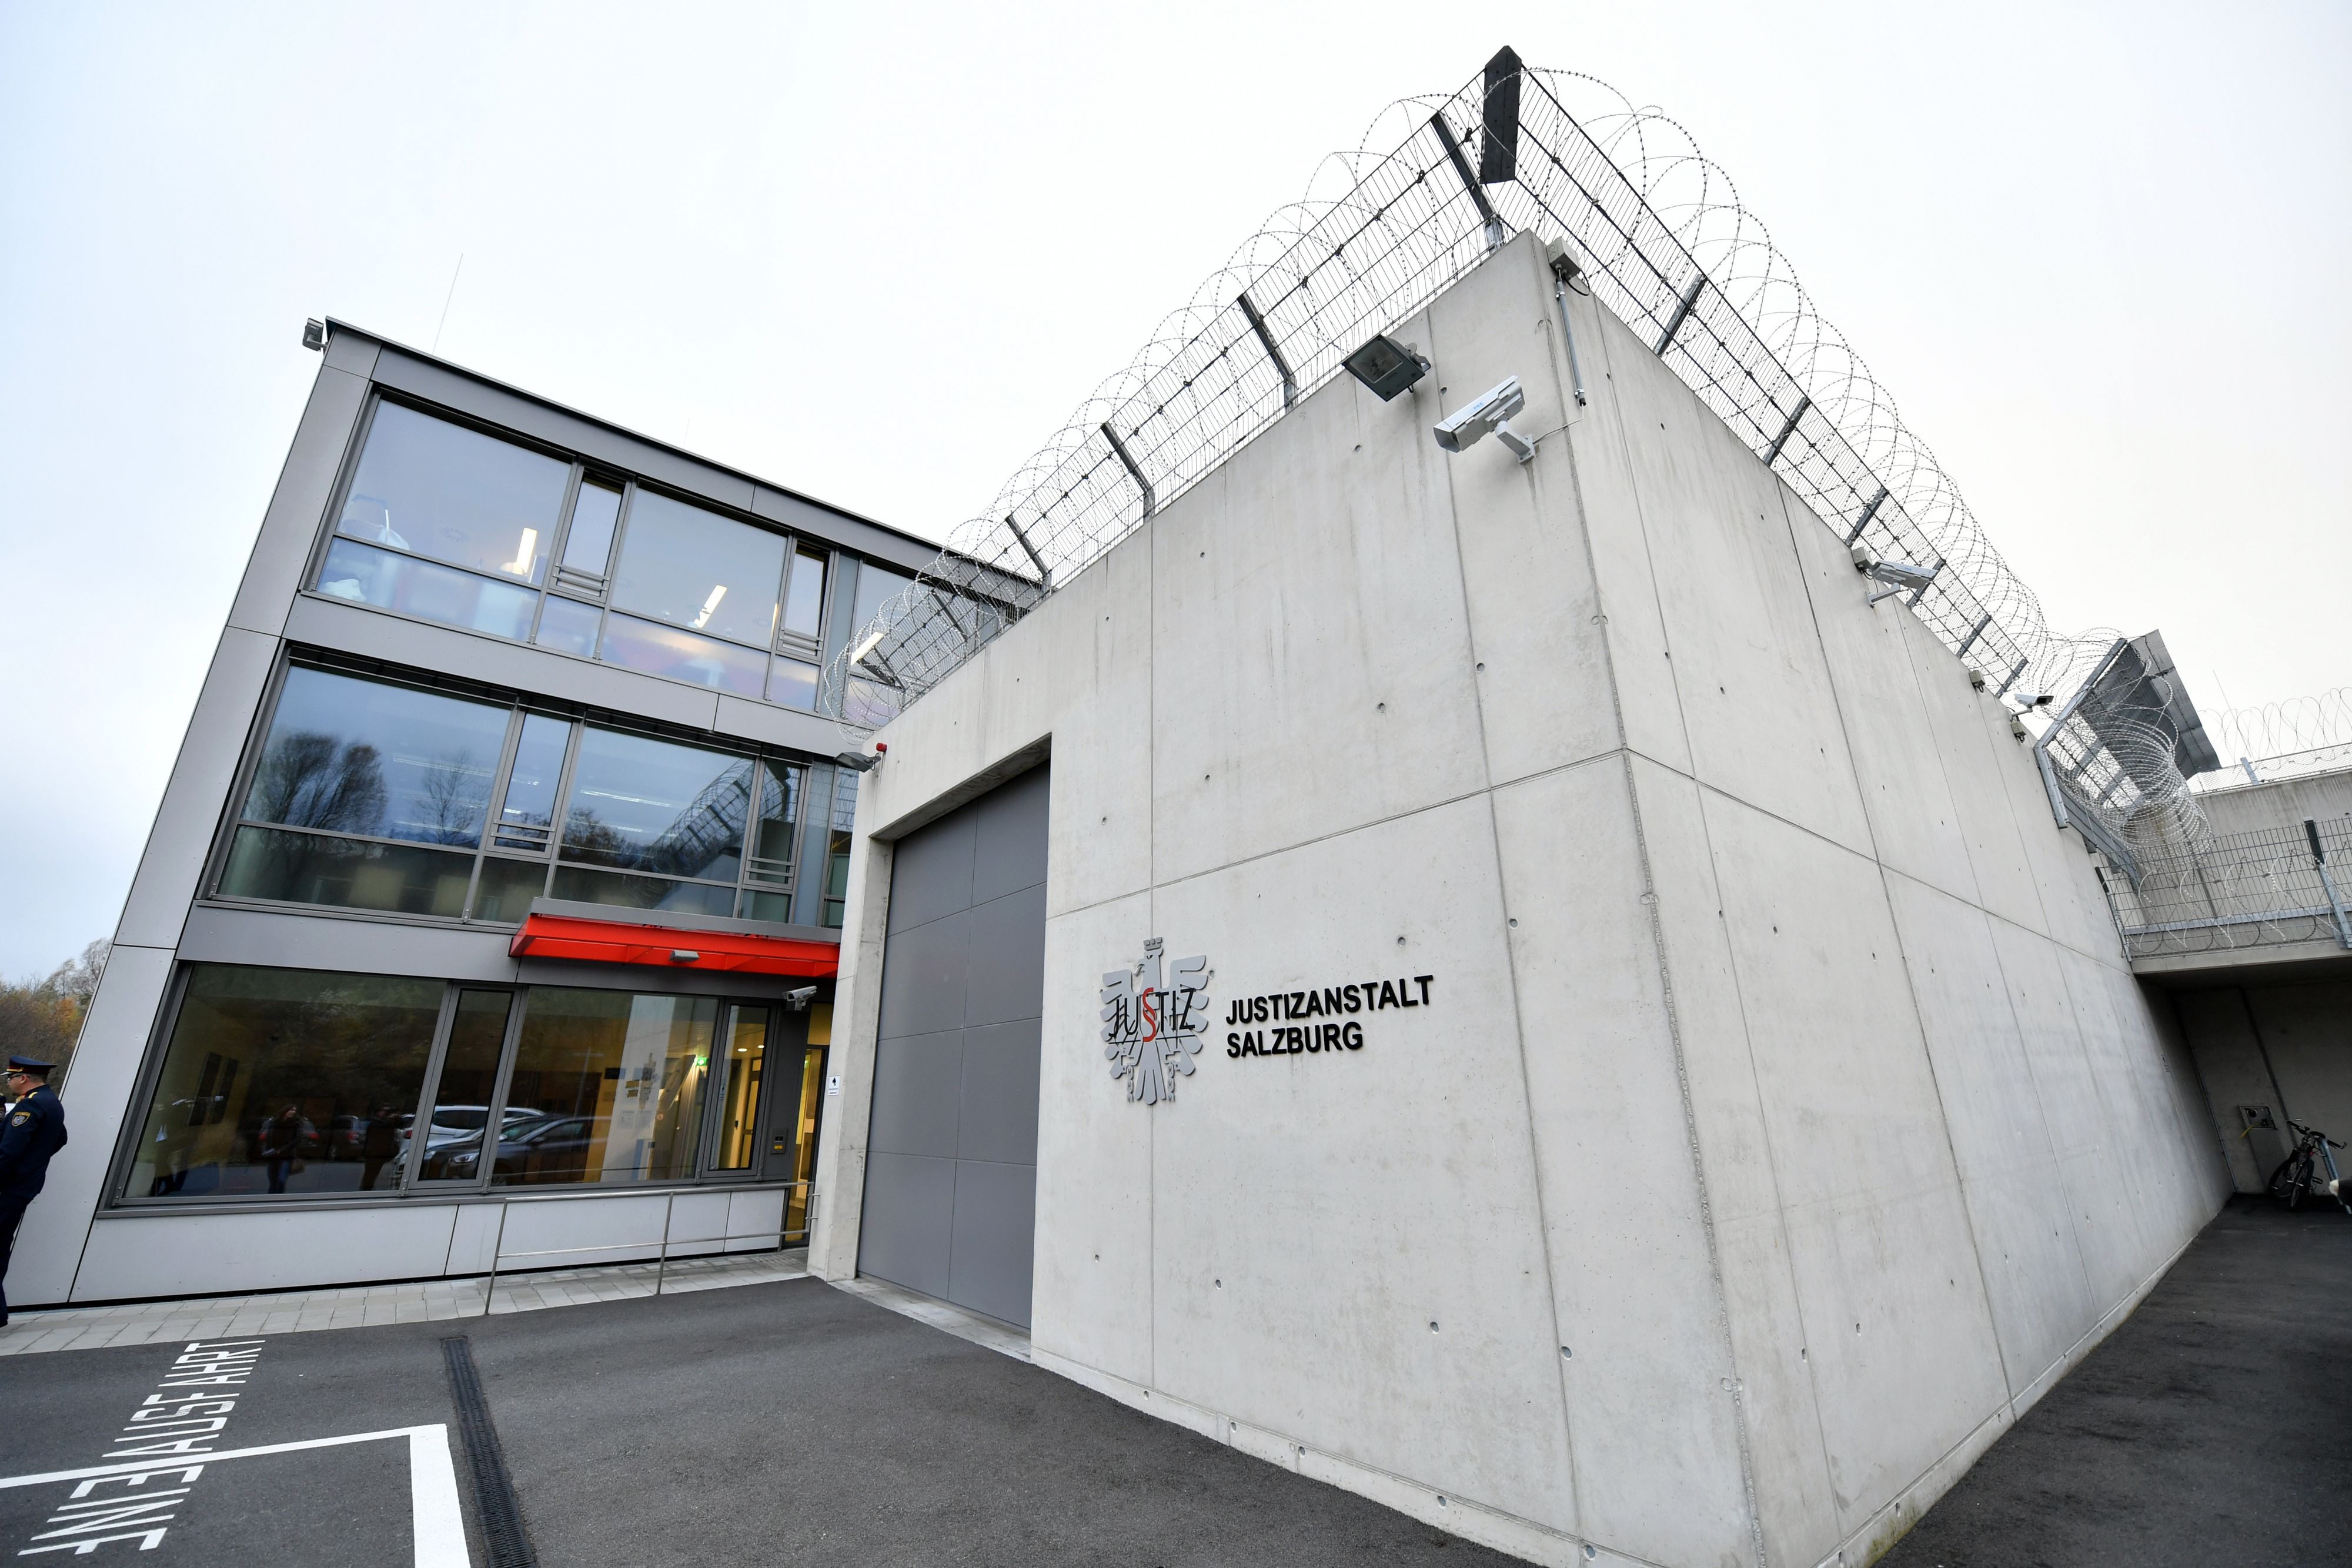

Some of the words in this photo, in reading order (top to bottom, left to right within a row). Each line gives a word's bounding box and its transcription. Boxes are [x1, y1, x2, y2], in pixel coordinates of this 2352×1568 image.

[1225, 975, 1434, 1025] JUSTIZANSTALT
[1227, 1022, 1363, 1059] SALZBURG
[102, 1340, 265, 1457] AUSFAHRT
